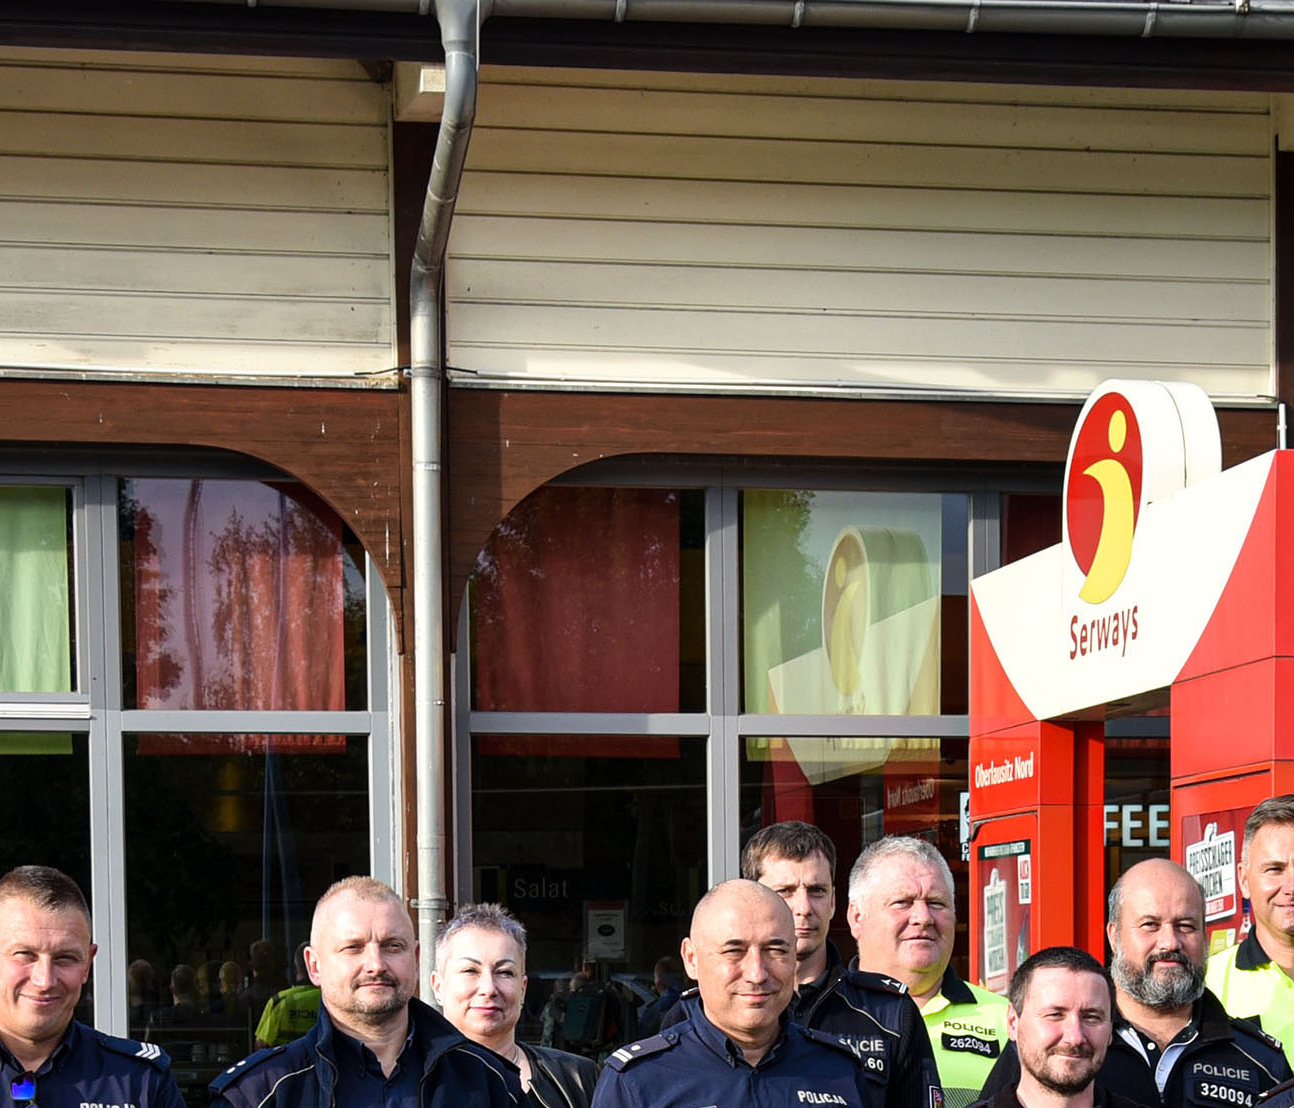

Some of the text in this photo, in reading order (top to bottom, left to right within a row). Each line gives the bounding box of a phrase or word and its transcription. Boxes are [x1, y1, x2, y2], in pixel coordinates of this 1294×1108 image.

[1070, 603, 1139, 660] Serways
[975, 752, 1034, 788] Oberlausitz Nord
[514, 878, 569, 898] Salat
[943, 1020, 997, 1037] POLICIE
[949, 1036, 992, 1055] 262094
[1193, 1062, 1251, 1081] POLICIE
[797, 1089, 848, 1106] POLICJA
[1200, 1082, 1253, 1108] 320094
